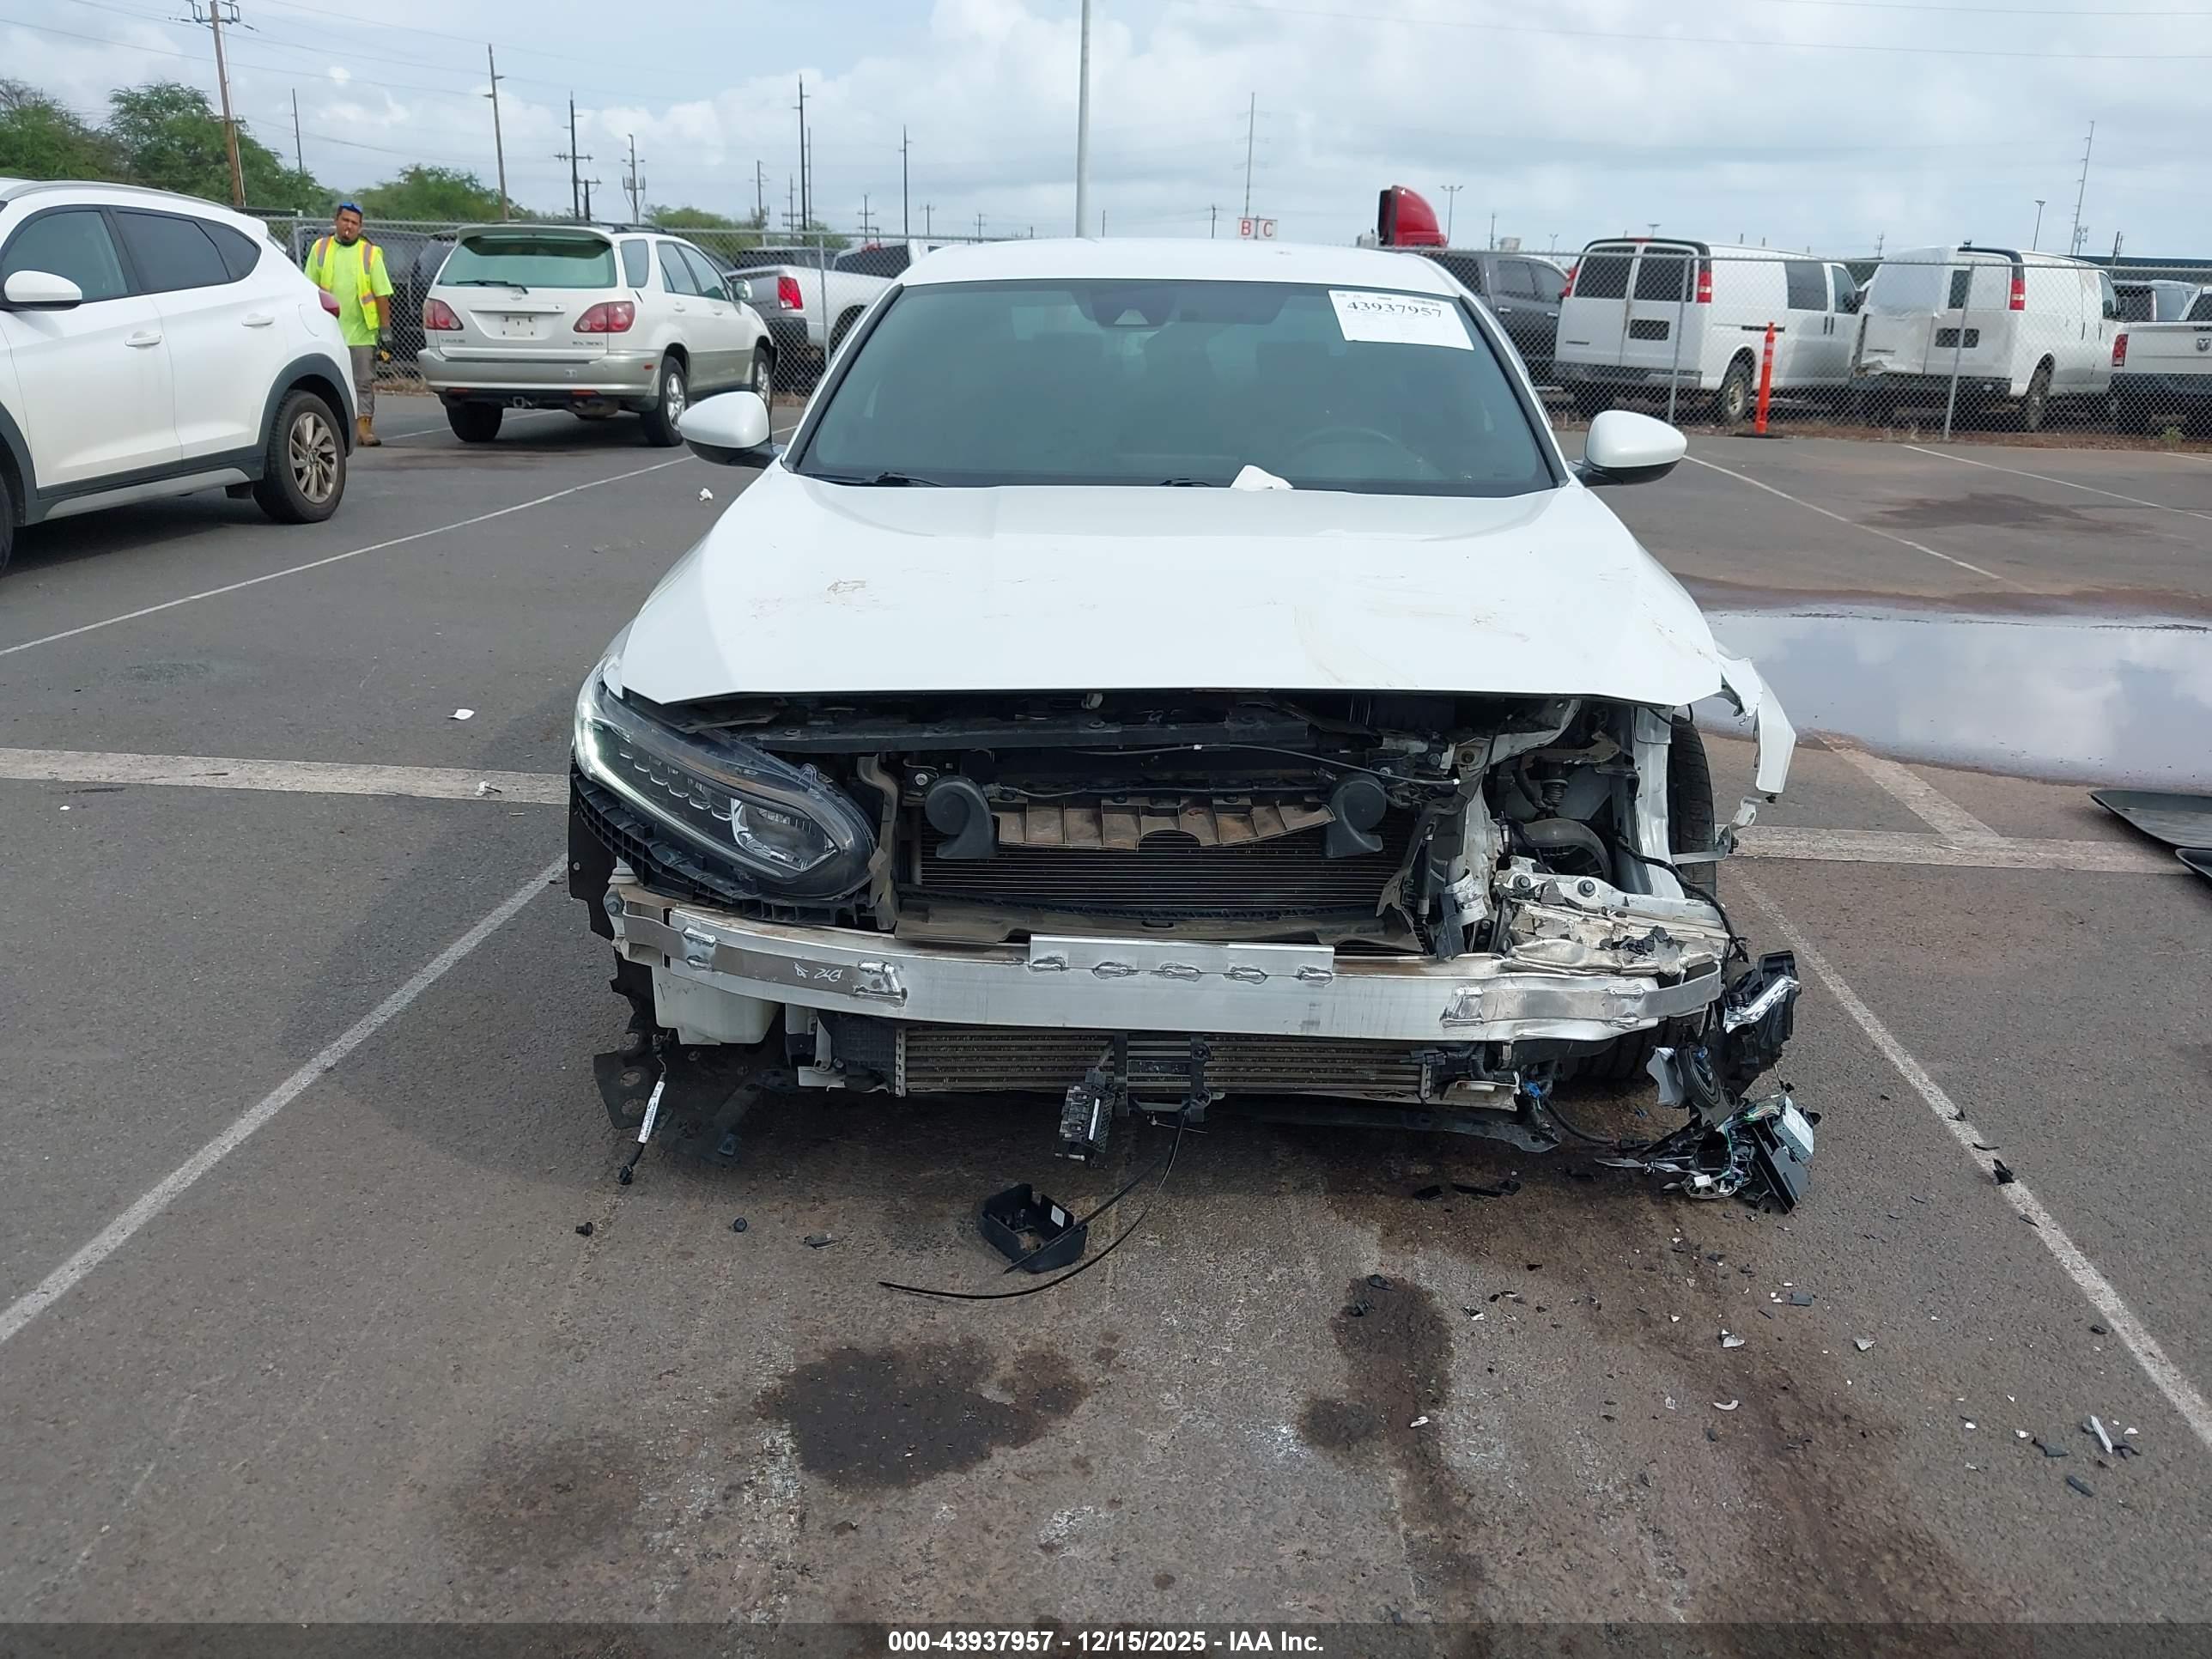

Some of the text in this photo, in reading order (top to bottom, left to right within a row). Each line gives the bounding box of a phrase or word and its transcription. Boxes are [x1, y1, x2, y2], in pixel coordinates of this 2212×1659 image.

[1241, 220, 1251, 236] B
[1263, 222, 1273, 238] C
[1346, 301, 1442, 318] 43937957
